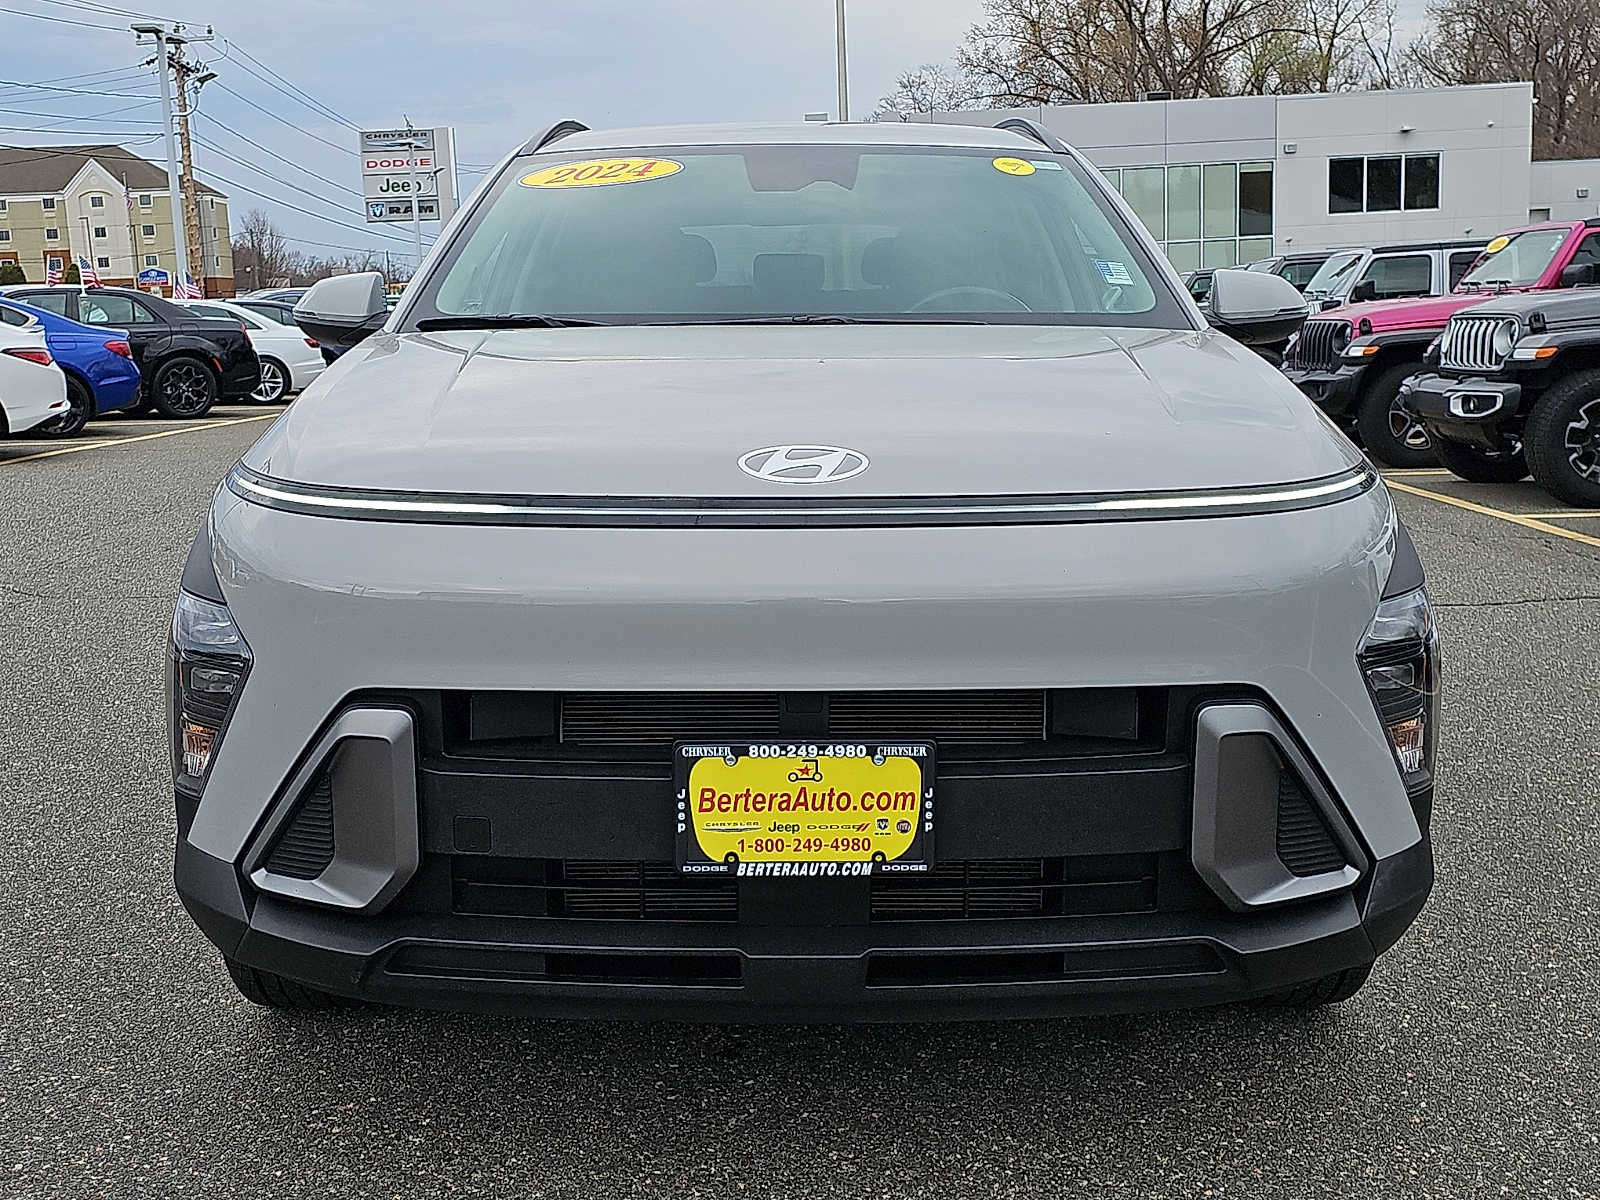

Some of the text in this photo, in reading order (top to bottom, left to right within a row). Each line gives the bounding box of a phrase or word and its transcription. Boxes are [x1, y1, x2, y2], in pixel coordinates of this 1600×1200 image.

[366, 158, 432, 168] DODGE
[544, 161, 657, 184] 2024
[388, 205, 434, 214] RAM
[682, 746, 732, 757] CHRYSLER
[748, 744, 867, 758] 800-249-4980
[877, 746, 927, 757] CHRYSLER
[698, 786, 917, 813] BerteraAuto.com
[677, 788, 686, 833] Jeep
[924, 787, 933, 832] Jeep
[768, 821, 801, 834] Jeep
[737, 838, 872, 852] 1-800-249-4980
[736, 862, 873, 876] BERTERAAUTO.COM
